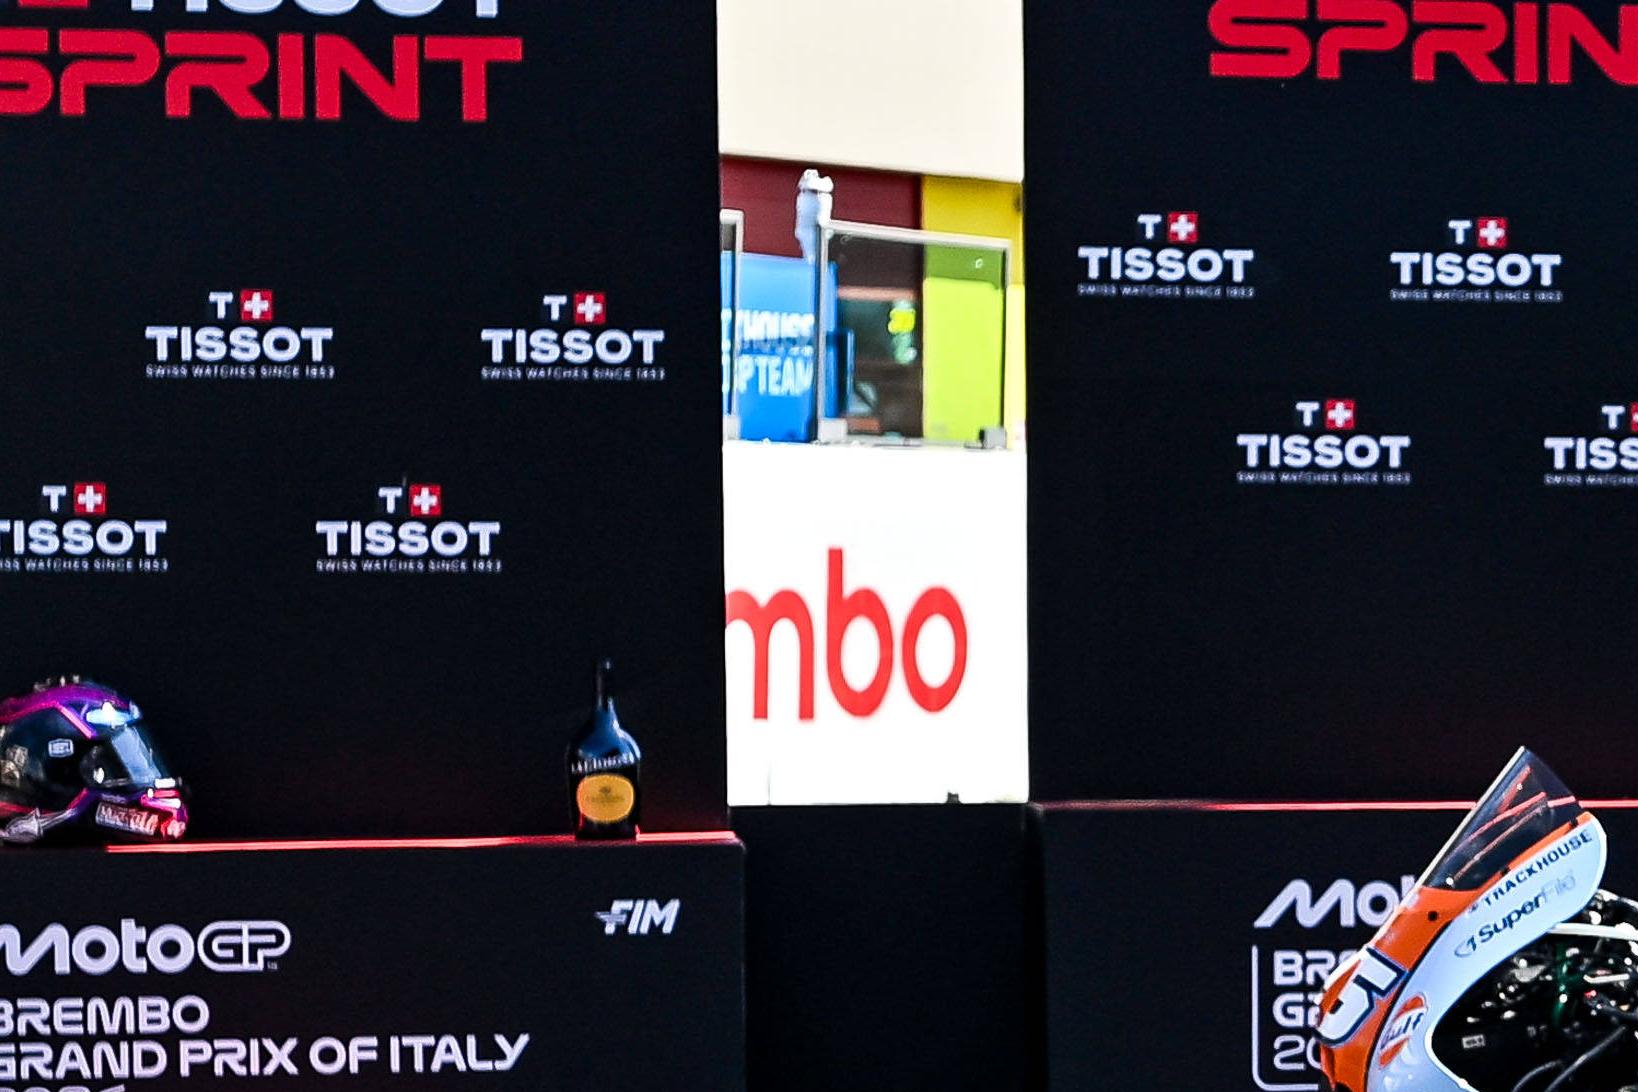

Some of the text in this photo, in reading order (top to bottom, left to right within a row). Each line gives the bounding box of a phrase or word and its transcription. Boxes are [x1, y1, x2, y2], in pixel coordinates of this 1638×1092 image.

[0, 28, 523, 121] SPRINT
[1078, 247, 1254, 282] TISSOT
[1390, 252, 1561, 286] TISSOT
[145, 326, 333, 361] TISSOT
[481, 329, 665, 363] TISSOT
[1236, 434, 1411, 468] TISSOT
[0, 519, 167, 555] TISSOT
[316, 521, 500, 556] TISSOT
[1482, 829, 1594, 906] TRACKHOUSE
[597, 899, 680, 935] FIM
[0, 995, 210, 1036] BREMBO
[179, 1037, 299, 1077] PRIX
[309, 1036, 379, 1075] OF
[389, 1033, 530, 1073] ITALY
